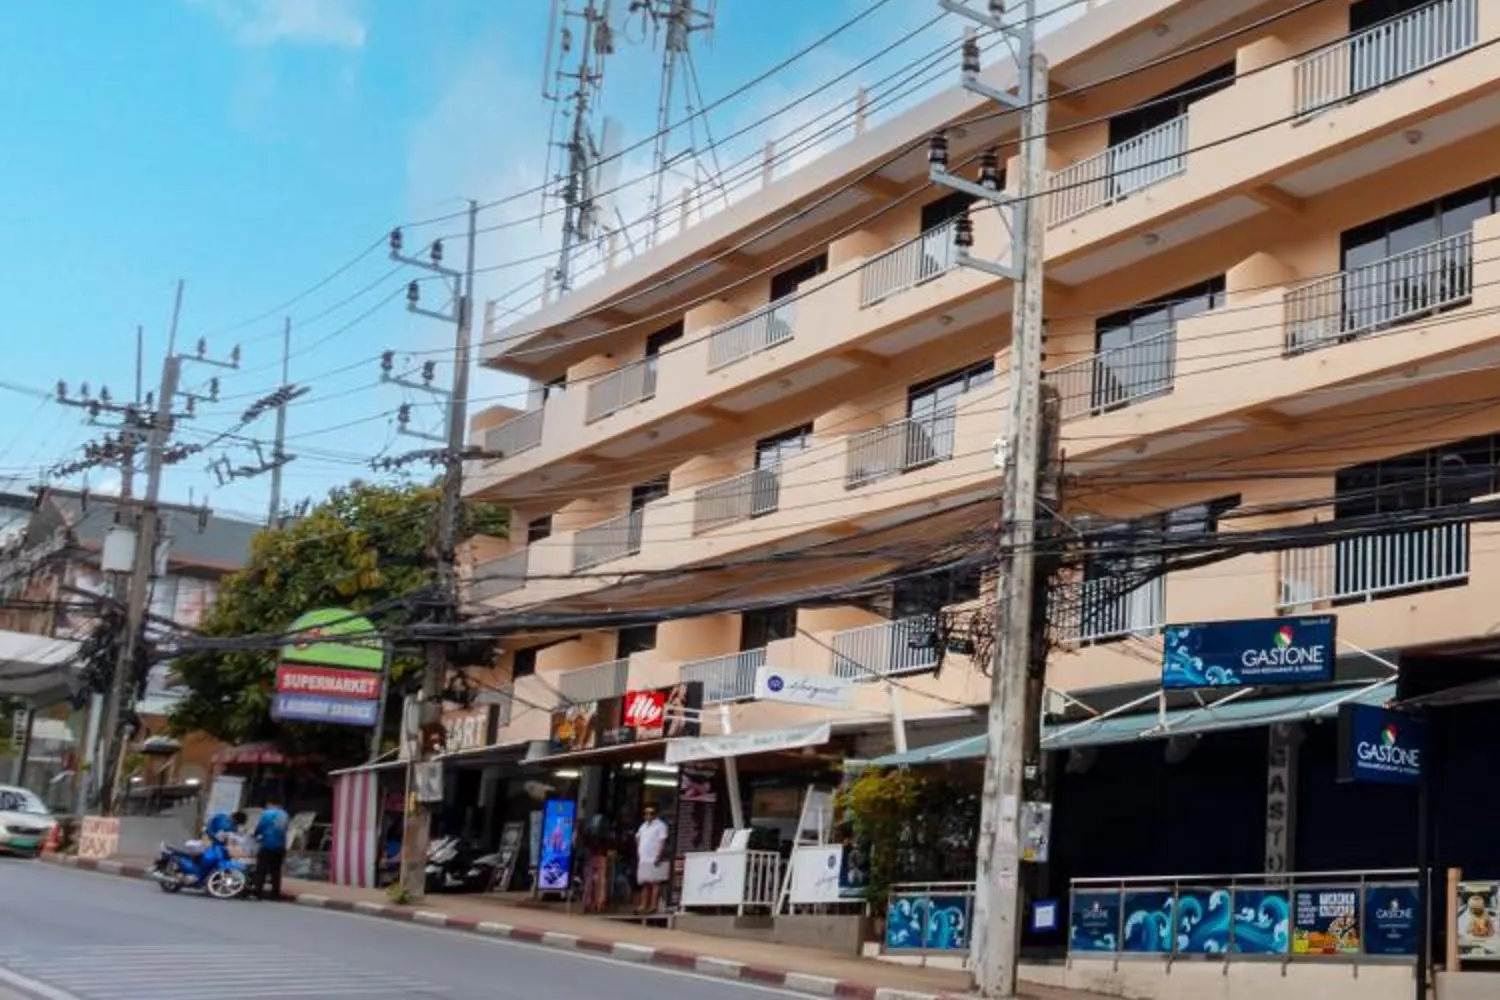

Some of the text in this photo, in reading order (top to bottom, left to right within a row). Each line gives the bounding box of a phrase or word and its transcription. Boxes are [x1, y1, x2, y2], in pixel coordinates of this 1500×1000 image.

[1241, 645, 1325, 667] GASTONE
[283, 673, 377, 694] SUPERMARKET
[1357, 741, 1420, 766] GASTONE
